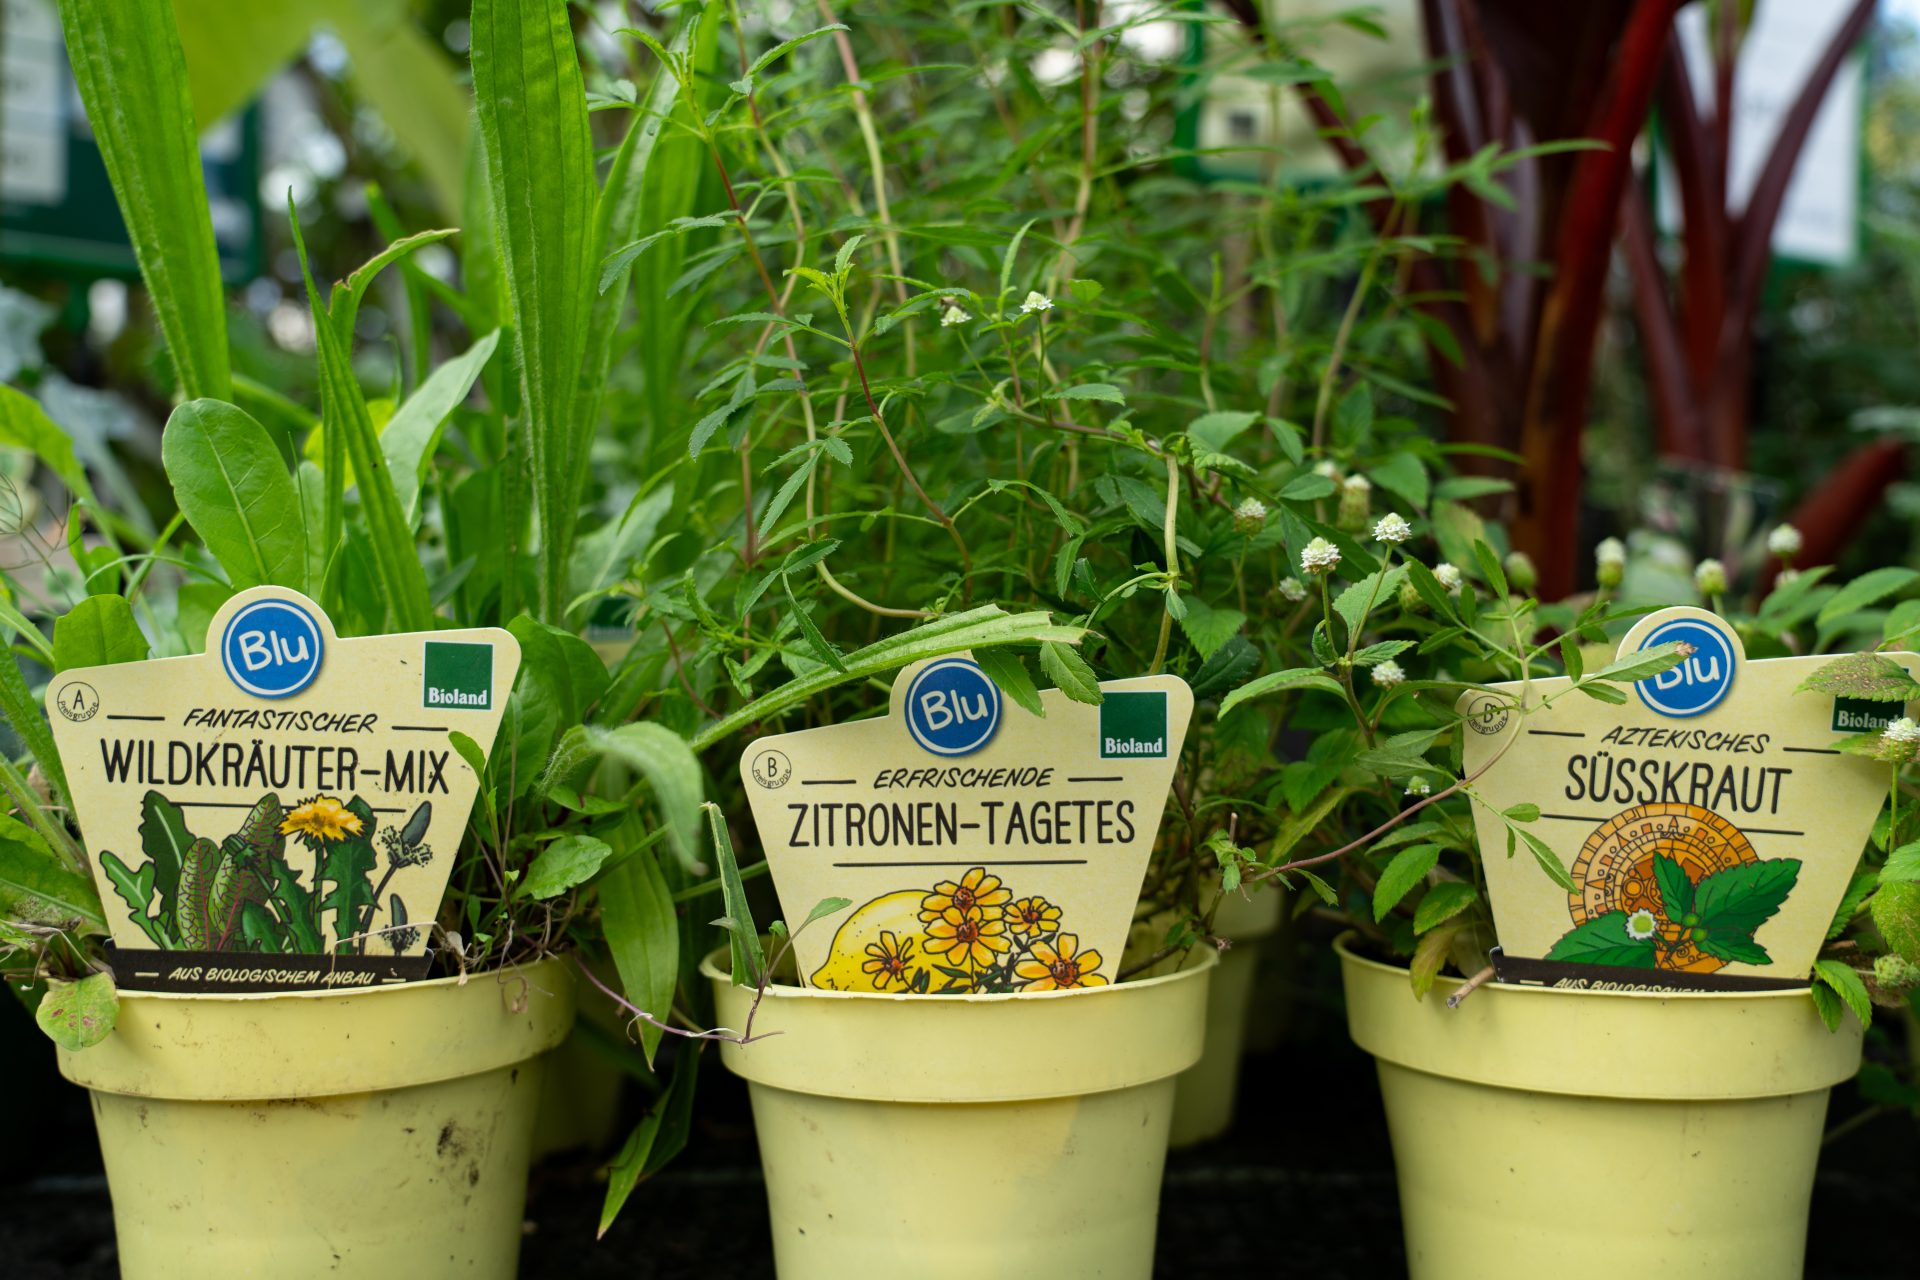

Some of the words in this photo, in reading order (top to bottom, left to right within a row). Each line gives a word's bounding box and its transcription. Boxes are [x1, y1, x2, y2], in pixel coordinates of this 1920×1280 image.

[239, 630, 309, 672] Blu
[72, 689, 85, 710] A
[427, 687, 488, 706] Bioland
[58, 700, 99, 721] Preisgruppe
[921, 689, 989, 731] Blu
[1483, 703, 1494, 723] B
[183, 708, 378, 734] FANTASTISCHER
[1105, 737, 1163, 755] Bioland
[1601, 726, 1770, 753] AZTEKISCHES
[100, 739, 450, 795] WILDKRÄUTER-MIX
[767, 757, 778, 778] B
[753, 769, 792, 788] Preisgruppe
[873, 767, 1055, 789] ERFRISCHENDE
[1564, 751, 1793, 815] SÜSSKRAUT
[787, 799, 1136, 847] ZITRONEN-TAGETES
[169, 967, 202, 980] AUS
[205, 967, 320, 983] BIOLOGISCHEM
[321, 972, 375, 985] ANBAU
[1553, 977, 1588, 989] AUS
[1589, 980, 1706, 992] BIOLOGIS
